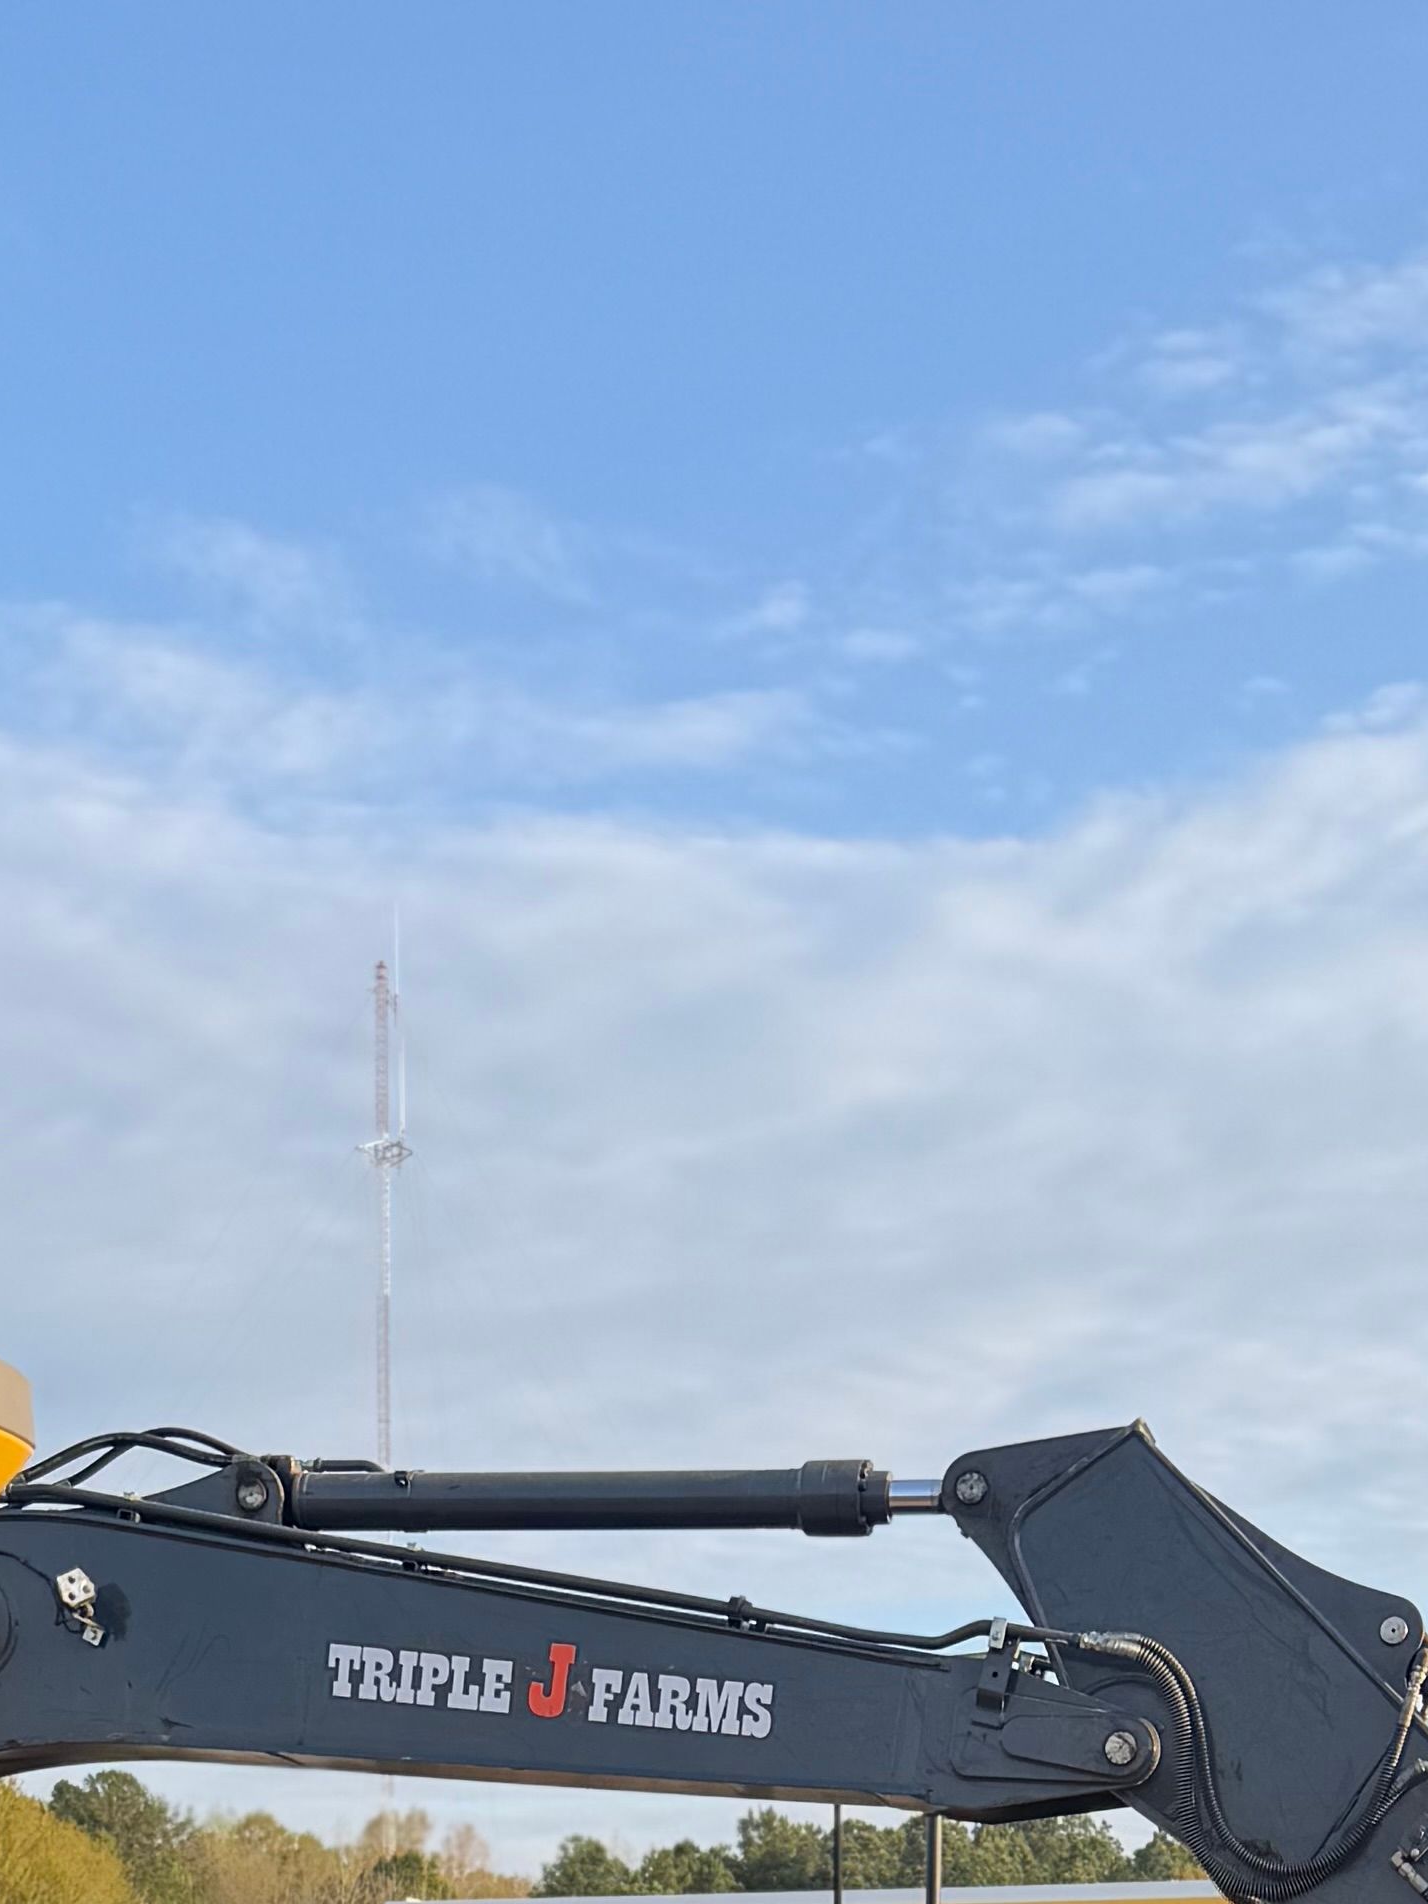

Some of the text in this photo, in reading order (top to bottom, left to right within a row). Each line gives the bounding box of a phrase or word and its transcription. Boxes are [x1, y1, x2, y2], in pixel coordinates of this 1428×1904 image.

[327, 1642, 774, 1739] TRIPLE J FARMS
